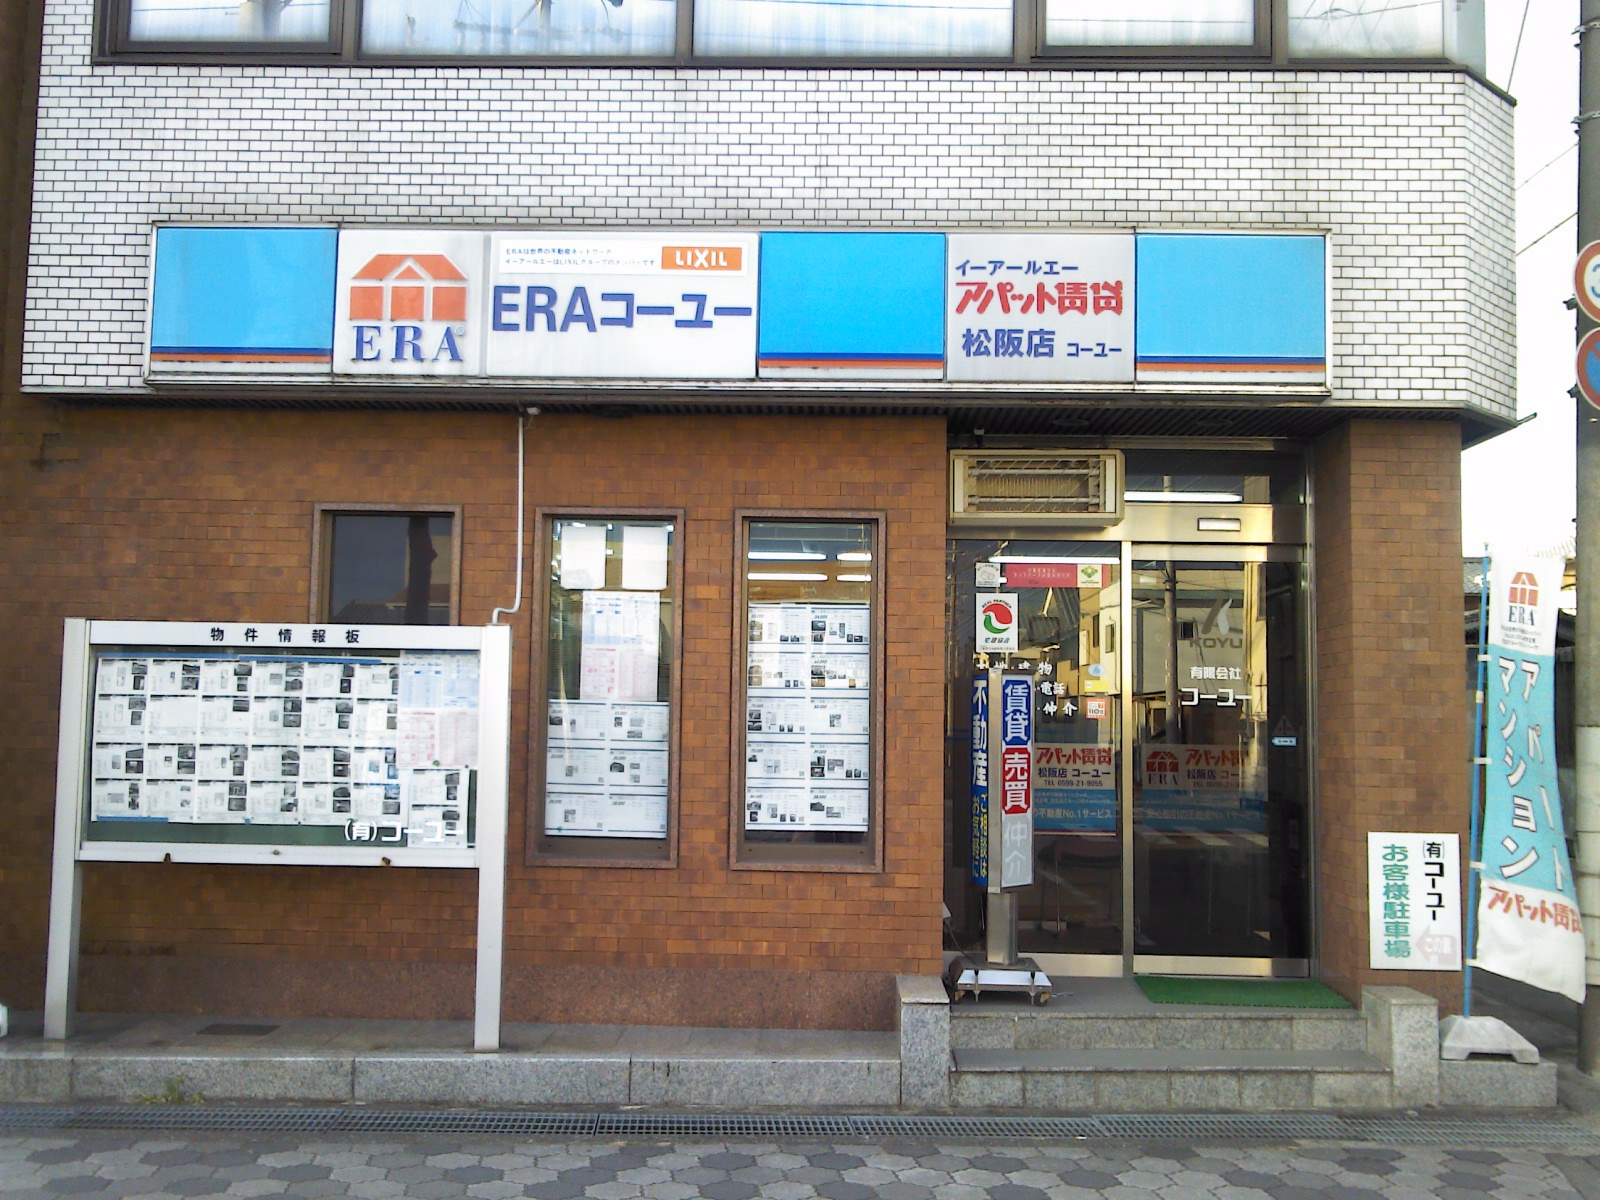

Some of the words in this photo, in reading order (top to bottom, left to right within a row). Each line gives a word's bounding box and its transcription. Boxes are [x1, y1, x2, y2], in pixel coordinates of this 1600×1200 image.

[675, 250, 728, 268] LIXIL
[956, 259, 1079, 276] イーアールエー
[492, 285, 752, 332] ERAコーユー
[351, 325, 464, 362] ERA
[962, 328, 1056, 357] 松阪店
[1067, 343, 1122, 357] コーユー
[1508, 605, 1535, 626] ERA
[211, 628, 360, 643] 物件情報板
[1190, 638, 1242, 648] KOYU
[1190, 666, 1242, 680] 有限会社
[1004, 684, 1029, 743] 賃貸
[1181, 688, 1252, 706] コーユー
[972, 680, 988, 787] 不動産
[1004, 752, 1028, 811] 売買
[1038, 767, 1067, 778] 松阪店
[1072, 769, 1110, 777] コーユー
[1498, 656, 1539, 879] マンション
[1521, 660, 1564, 890] アパート
[1004, 822, 1028, 877] 仲介
[1382, 844, 1411, 958] お客様駐車場
